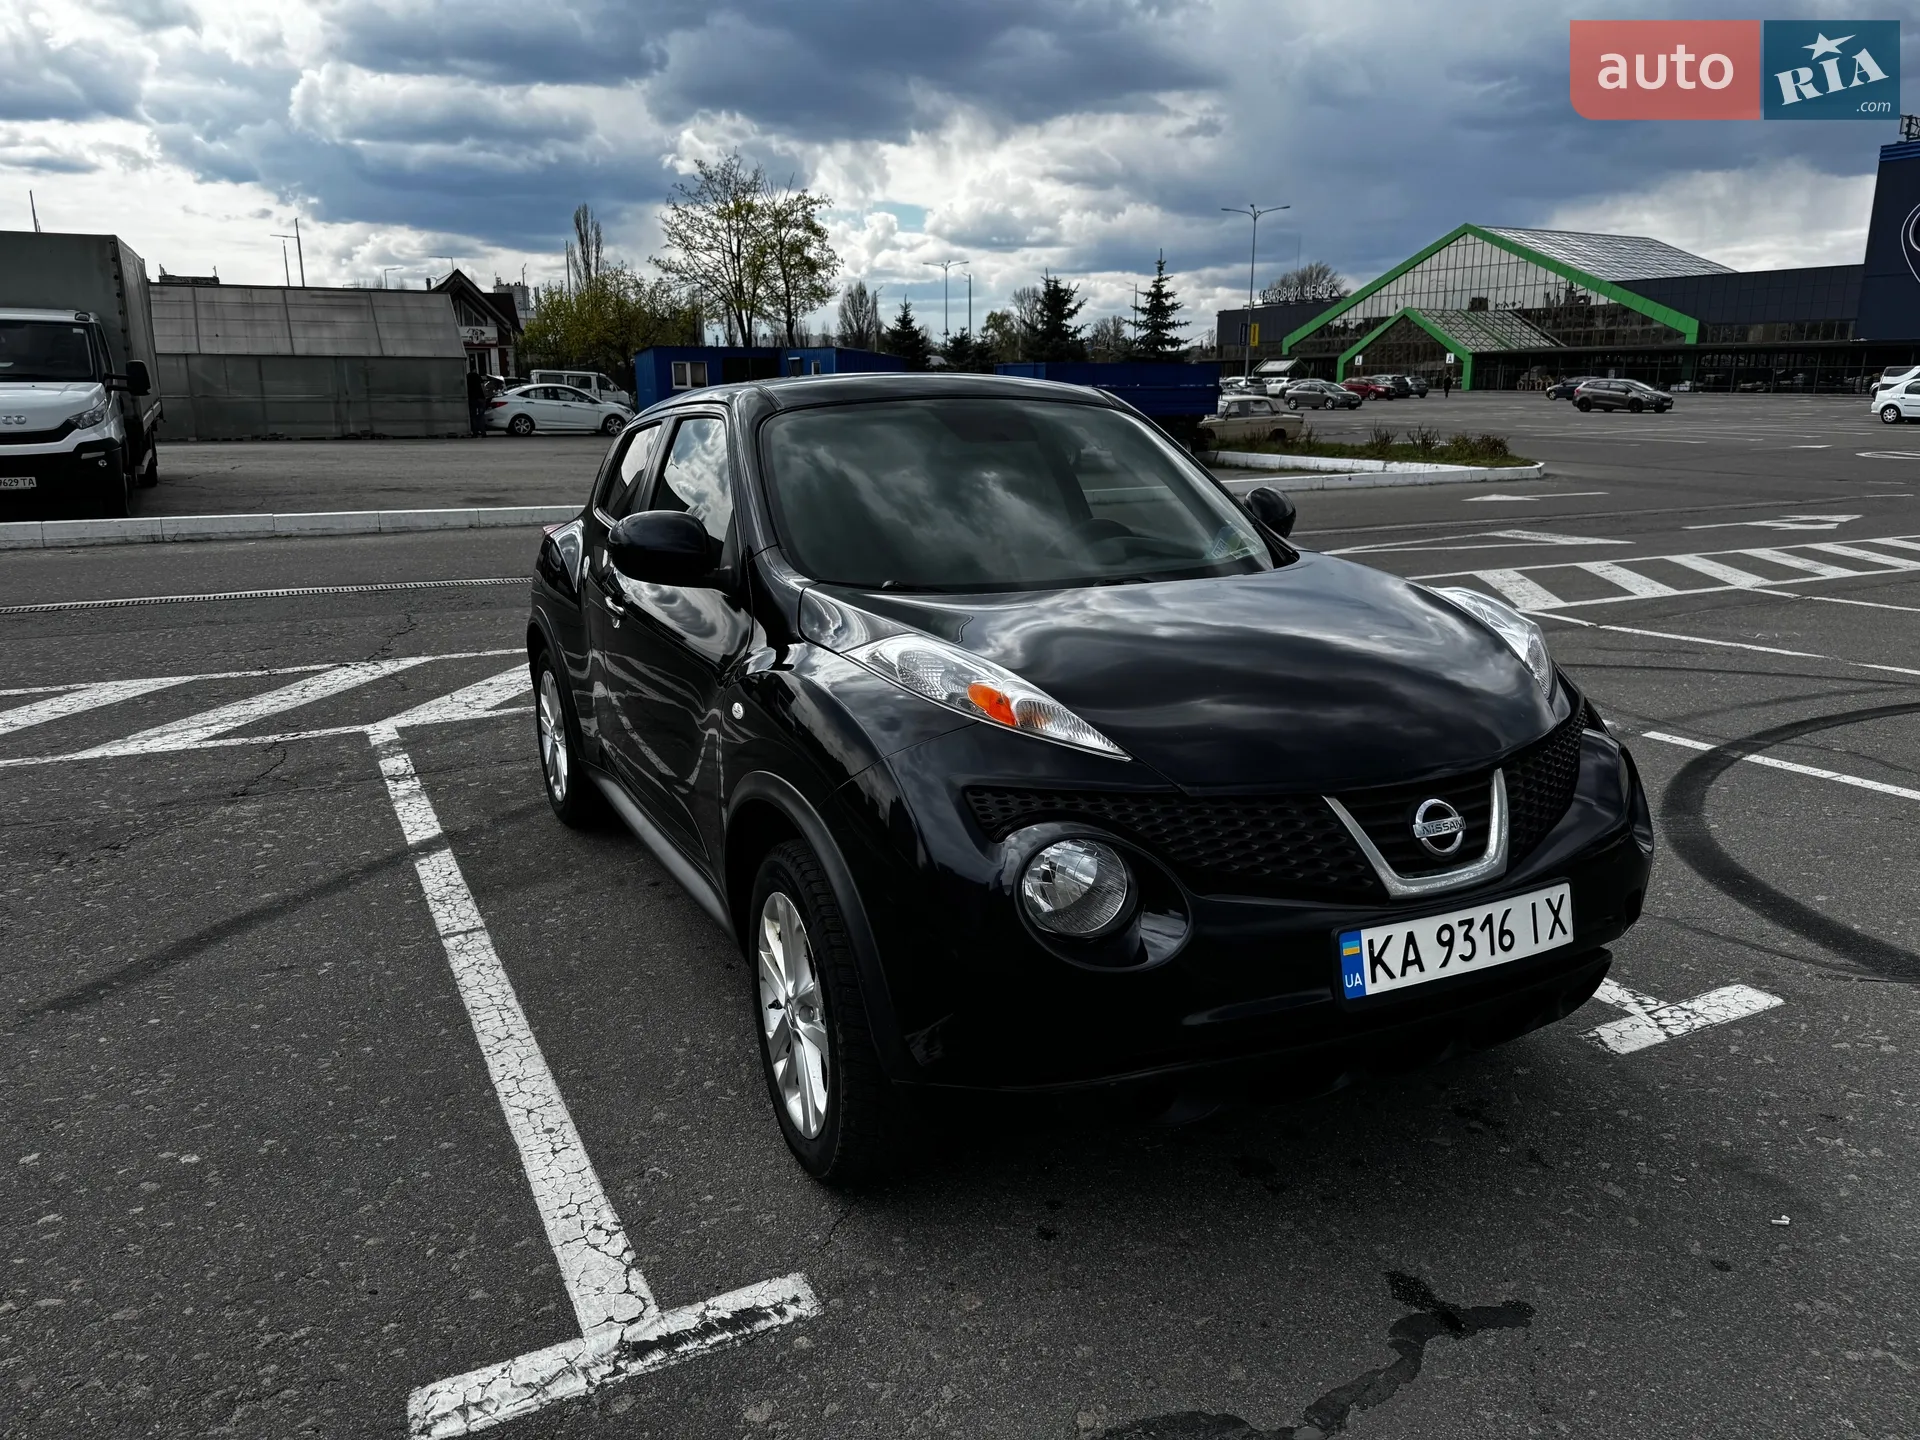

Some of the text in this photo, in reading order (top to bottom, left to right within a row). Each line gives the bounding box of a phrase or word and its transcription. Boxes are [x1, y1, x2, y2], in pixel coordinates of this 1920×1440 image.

[1422, 819, 1464, 835] NISSAN
[1367, 893, 1568, 984] KA 9316 IX
[1344, 972, 1363, 989] UA
